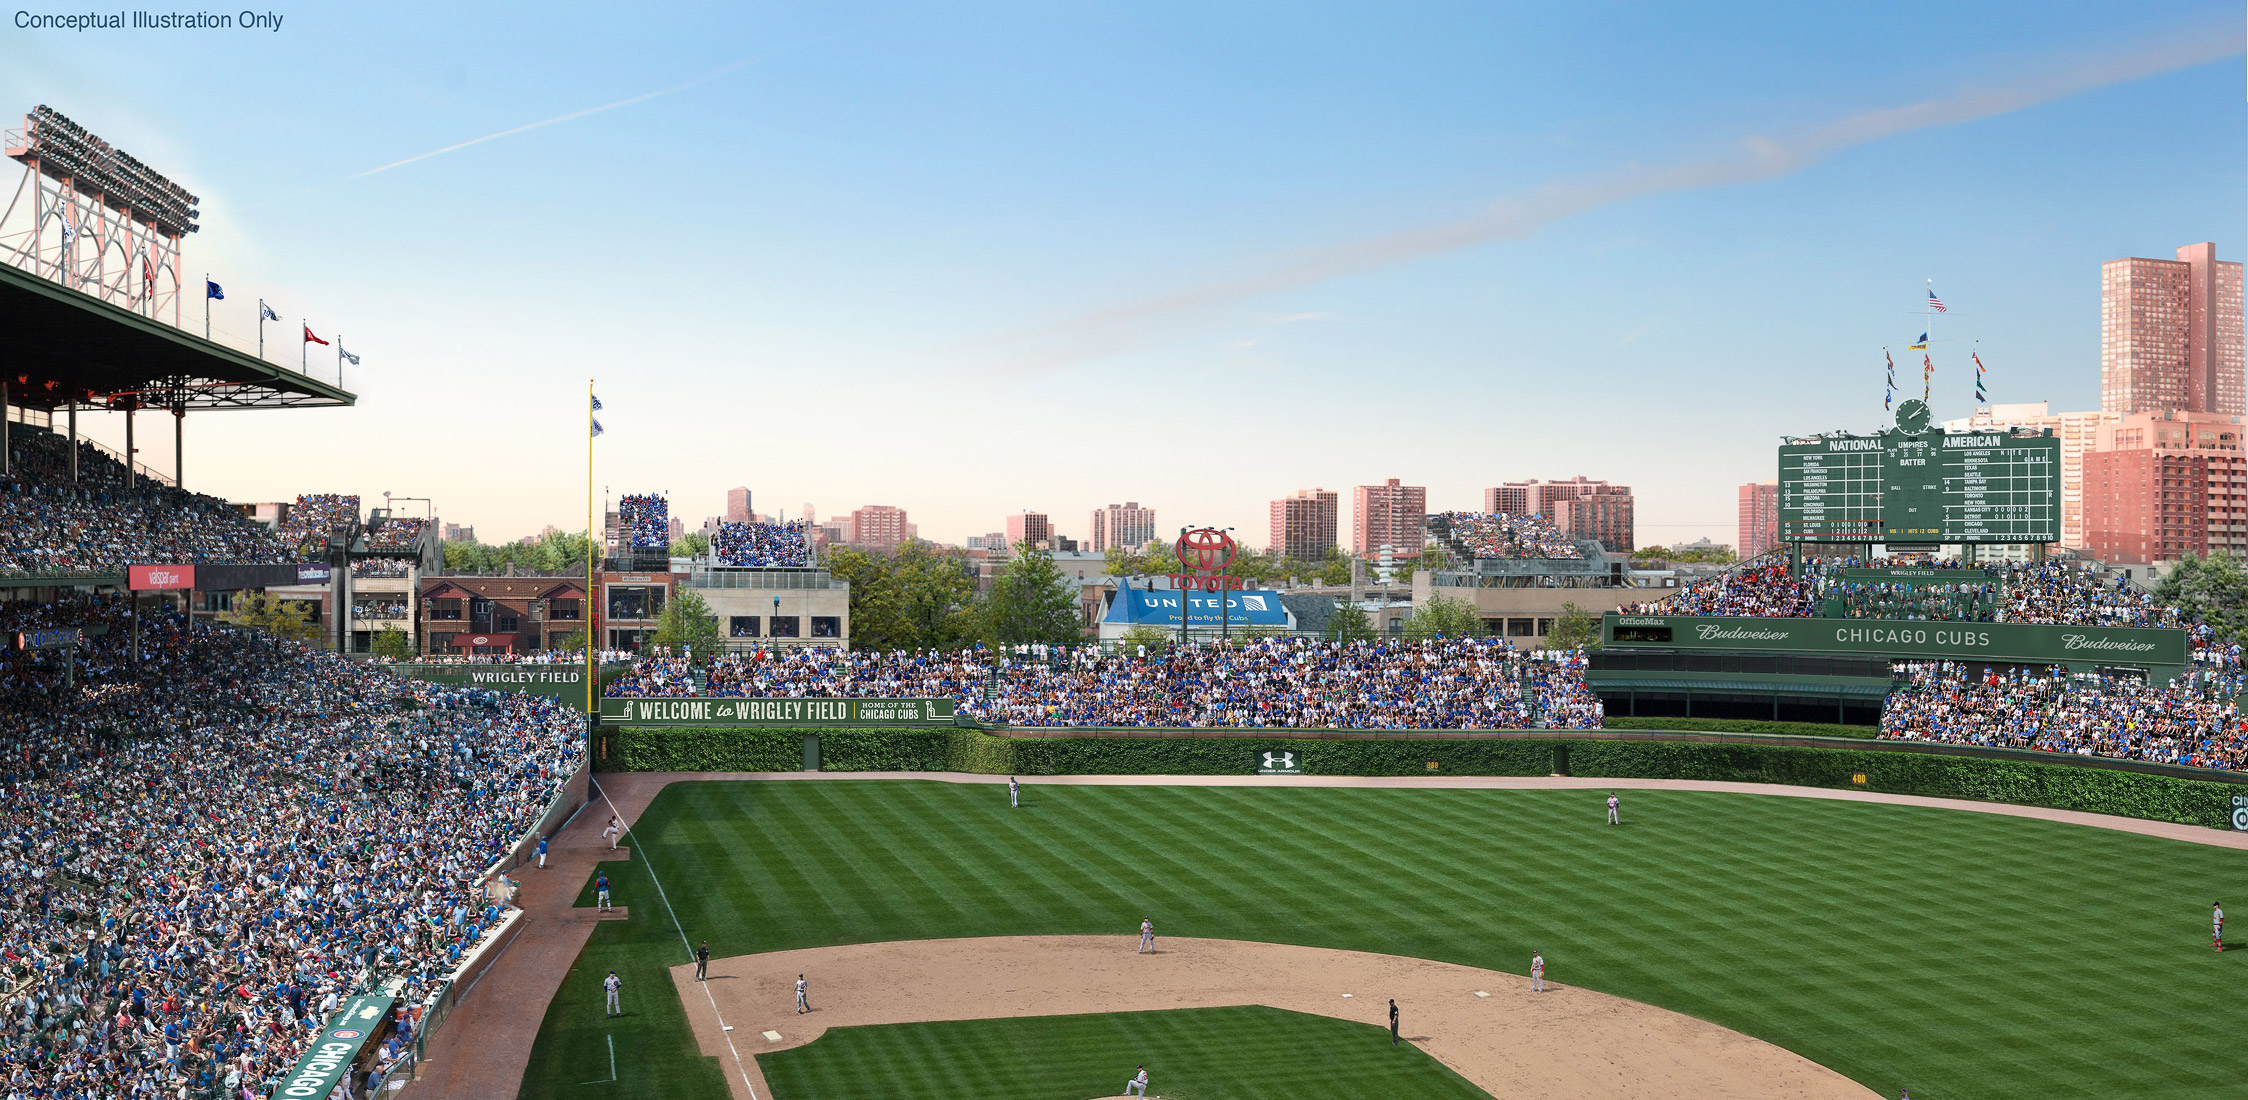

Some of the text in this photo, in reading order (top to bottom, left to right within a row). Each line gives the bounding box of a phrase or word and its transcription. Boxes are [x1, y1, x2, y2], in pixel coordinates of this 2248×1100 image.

[1829, 440, 1884, 451] NATIONAL
[1942, 436, 2000, 448] AMERICAN
[149, 567, 179, 588] valspar paint
[1166, 574, 1244, 591] TOYOTA
[1144, 599, 1238, 608] UNTED
[1696, 624, 1789, 640] Budweiser
[1836, 629, 1990, 646] CHICAGO CUBS
[2061, 634, 2155, 651] Budweiser
[472, 672, 579, 683] WRIGLEY FIELD
[640, 702, 846, 719] WELCOME to WRIGLEY FIELD
[860, 709, 919, 719] CHICAGO CUBS
[1853, 774, 1865, 783] 400
[284, 1042, 352, 1096] CHICAGO
